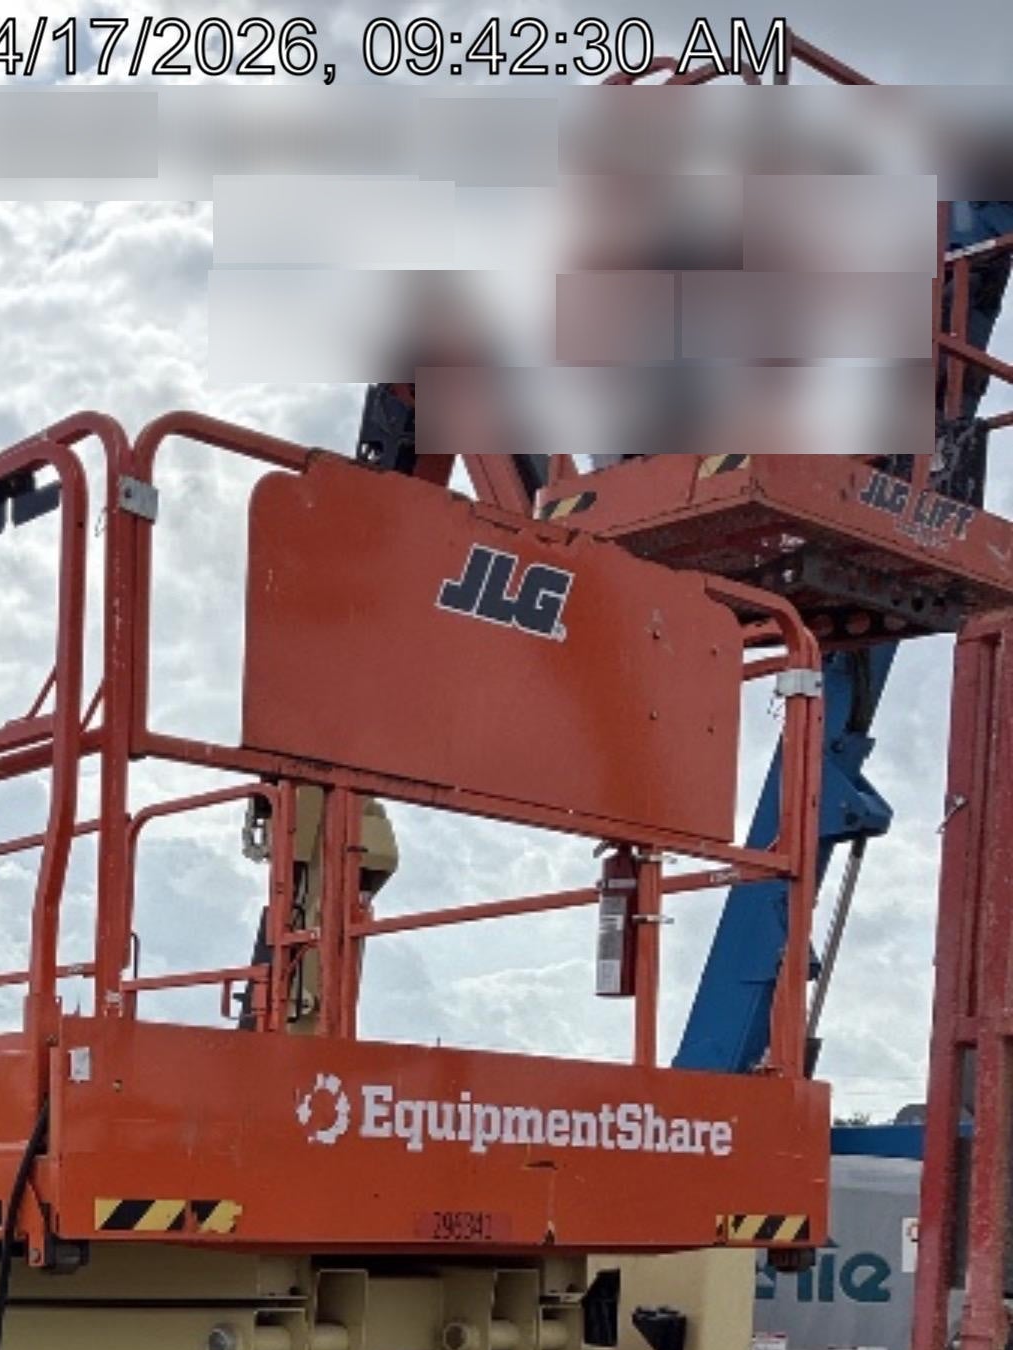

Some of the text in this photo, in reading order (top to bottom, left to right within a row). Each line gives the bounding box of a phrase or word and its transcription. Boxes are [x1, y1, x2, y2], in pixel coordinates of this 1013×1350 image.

[860, 470, 912, 515] JLG
[434, 543, 575, 641] JLG
[360, 1084, 733, 1156] EquipmentShare
